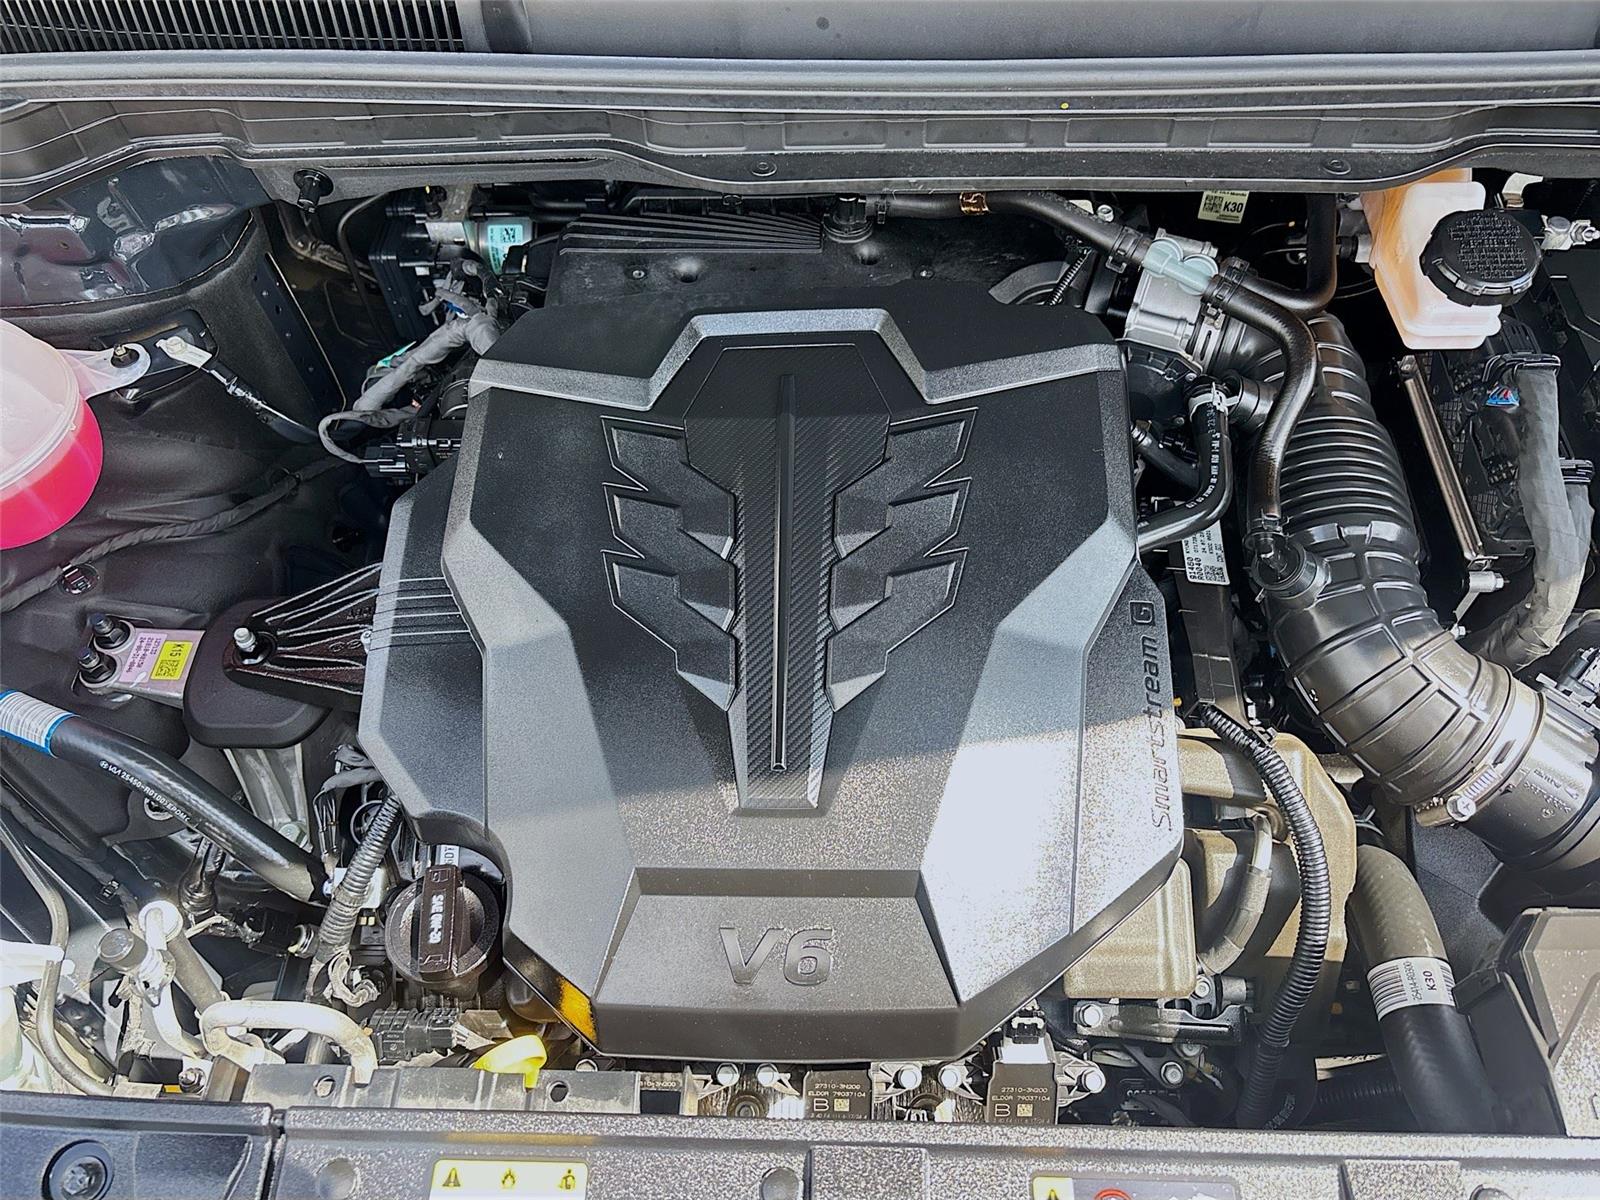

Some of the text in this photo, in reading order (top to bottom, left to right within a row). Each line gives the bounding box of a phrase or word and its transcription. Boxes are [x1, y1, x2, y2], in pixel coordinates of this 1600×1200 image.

[1223, 201, 1244, 213] K30
[1186, 556, 1197, 579] 91460
[1194, 557, 1205, 580] R0040
[169, 643, 185, 657] K15
[1140, 636, 1172, 831] Smartstream
[428, 894, 444, 944] SAE 0W-20
[719, 927, 834, 986] V6
[1423, 970, 1438, 991] K30
[813, 1097, 830, 1112] B
[995, 1103, 1011, 1117] B
